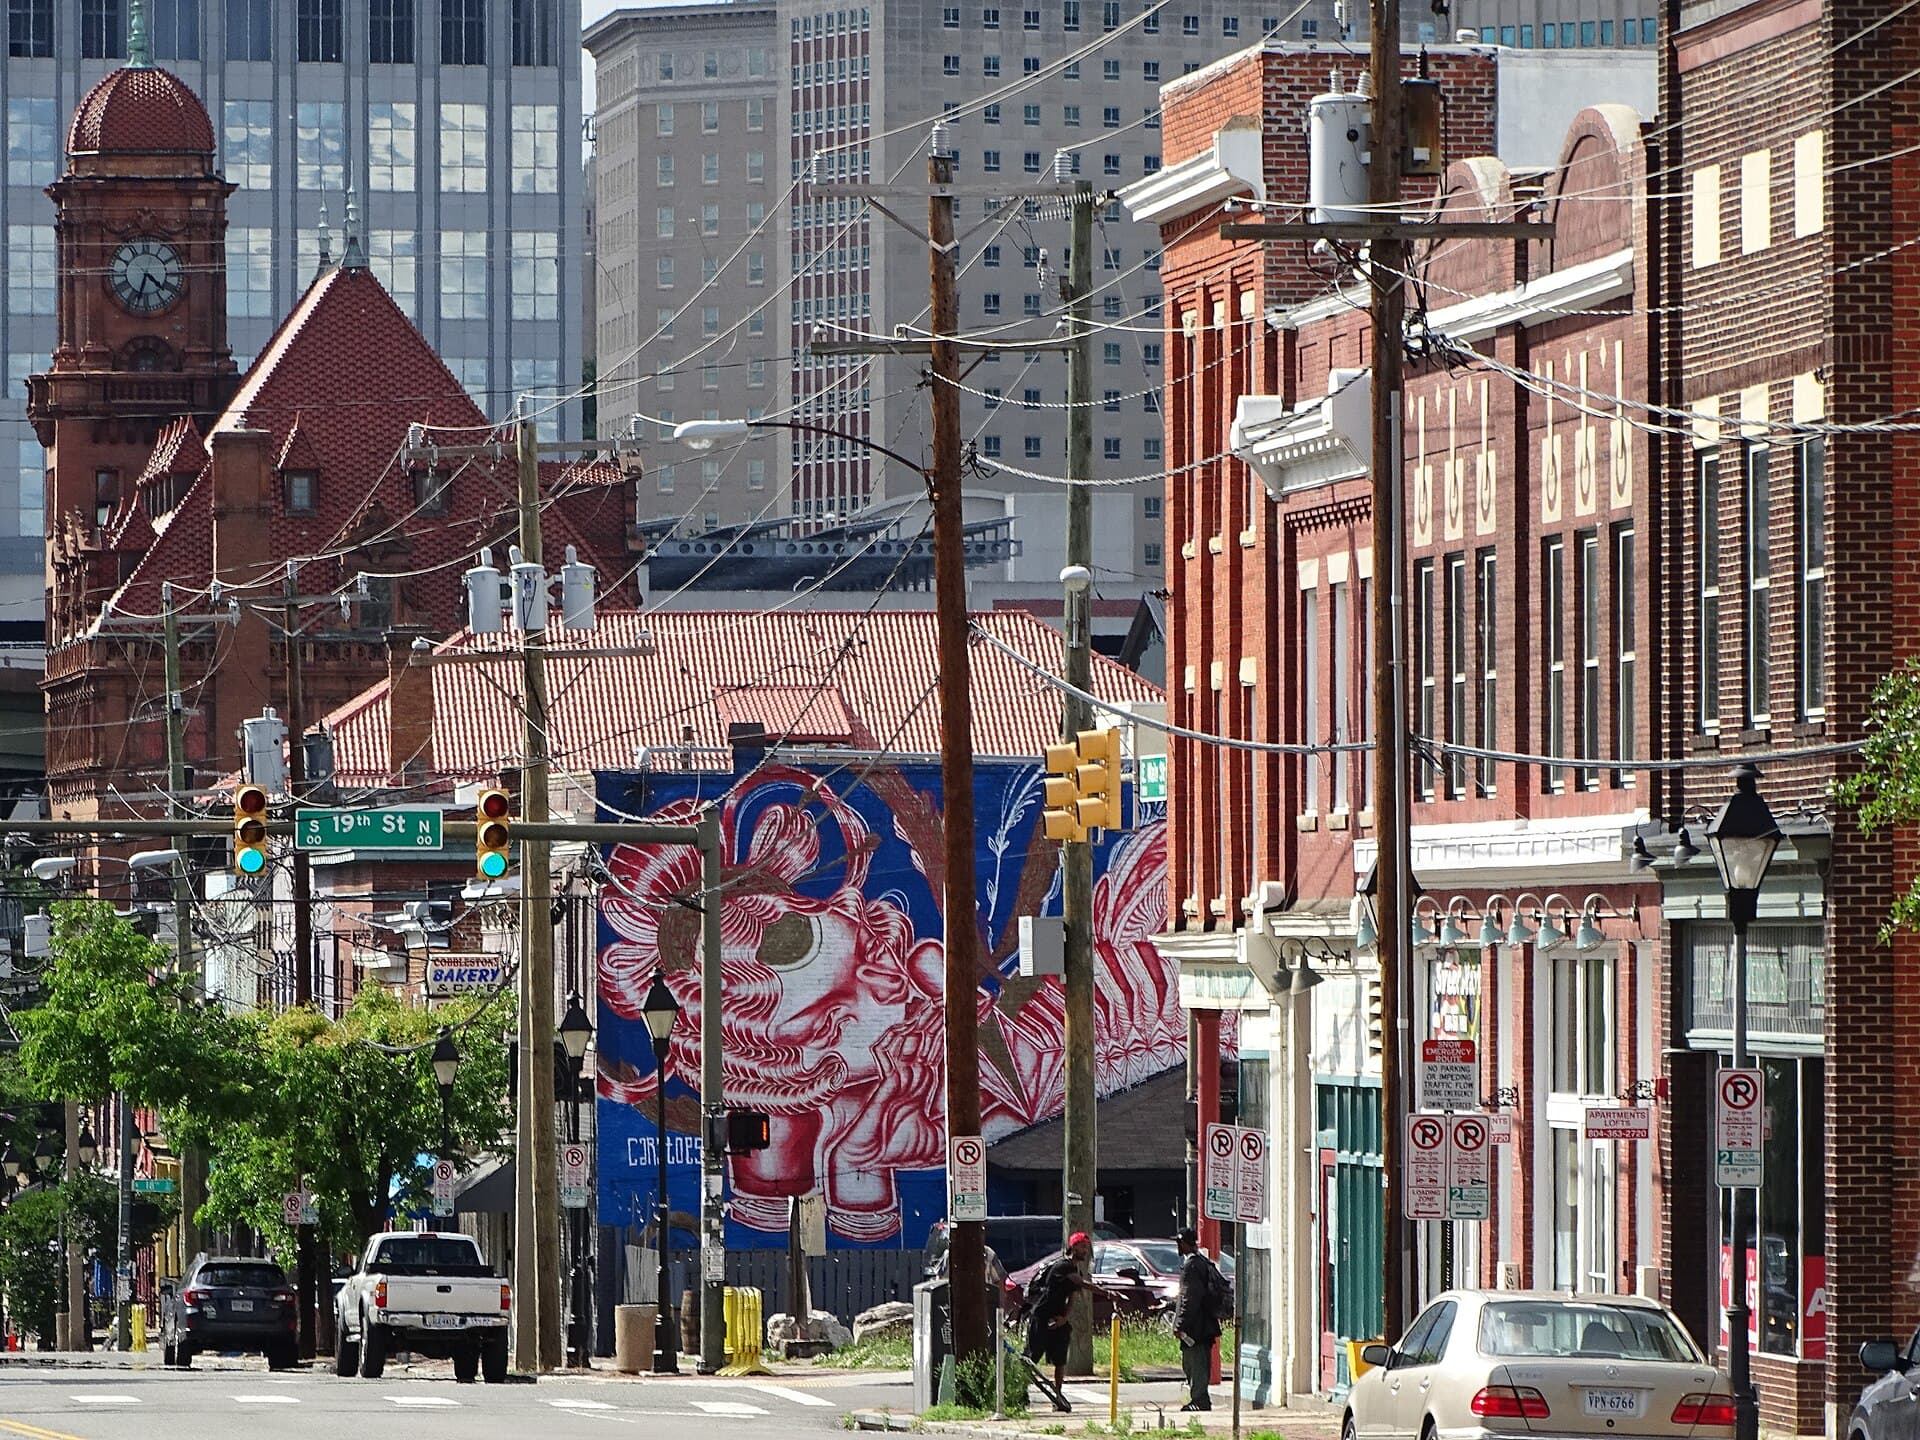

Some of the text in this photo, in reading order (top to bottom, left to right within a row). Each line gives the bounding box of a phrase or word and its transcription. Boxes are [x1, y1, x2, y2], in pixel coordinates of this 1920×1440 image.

[309, 814, 430, 833] S 19th St N
[306, 835, 432, 845] 00 00
[433, 968, 500, 982] BAKERY
[437, 984, 448, 992] &
[1437, 1041, 1462, 1049] SNOW
[1425, 1048, 1472, 1056] EMERGENCY
[1435, 1055, 1463, 1063] ROUTE
[1427, 1065, 1471, 1073] NO PARKING
[1426, 1073, 1472, 1081] OR IMPEDING
[1424, 1081, 1473, 1089] TRAFFIC FLOW
[1589, 1111, 1646, 1119] APARTMENTS
[1604, 1119, 1631, 1127] LOFTS
[1720, 1151, 1730, 1164] 2
[1451, 1188, 1461, 1200] 2
